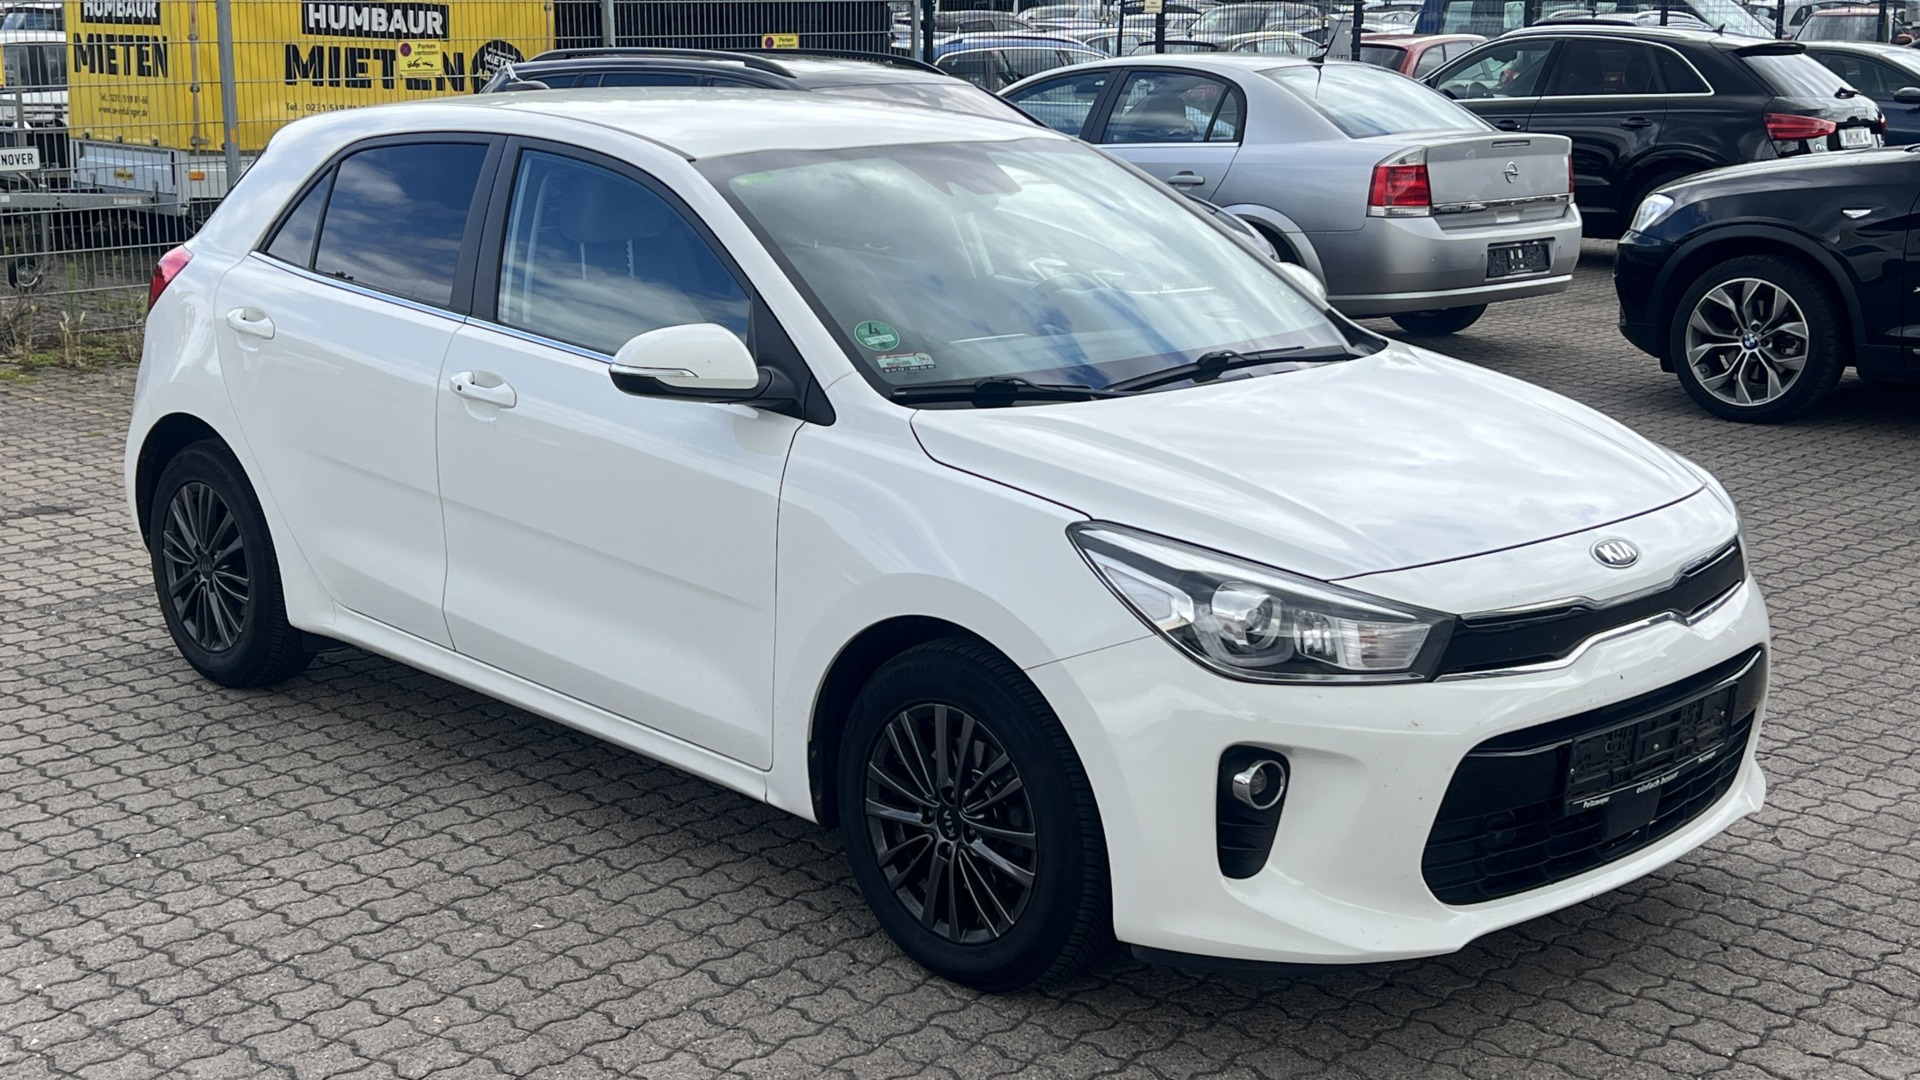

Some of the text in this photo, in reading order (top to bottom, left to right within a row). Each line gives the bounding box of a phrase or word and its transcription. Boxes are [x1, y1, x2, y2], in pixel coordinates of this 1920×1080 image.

[83, 0, 157, 18] HUMBAUR
[308, 3, 443, 35] HUMBAUR
[73, 33, 168, 78] MIETEN
[868, 323, 881, 335] 4
[1597, 541, 1637, 563] KIA
[943, 809, 956, 837] KIA
